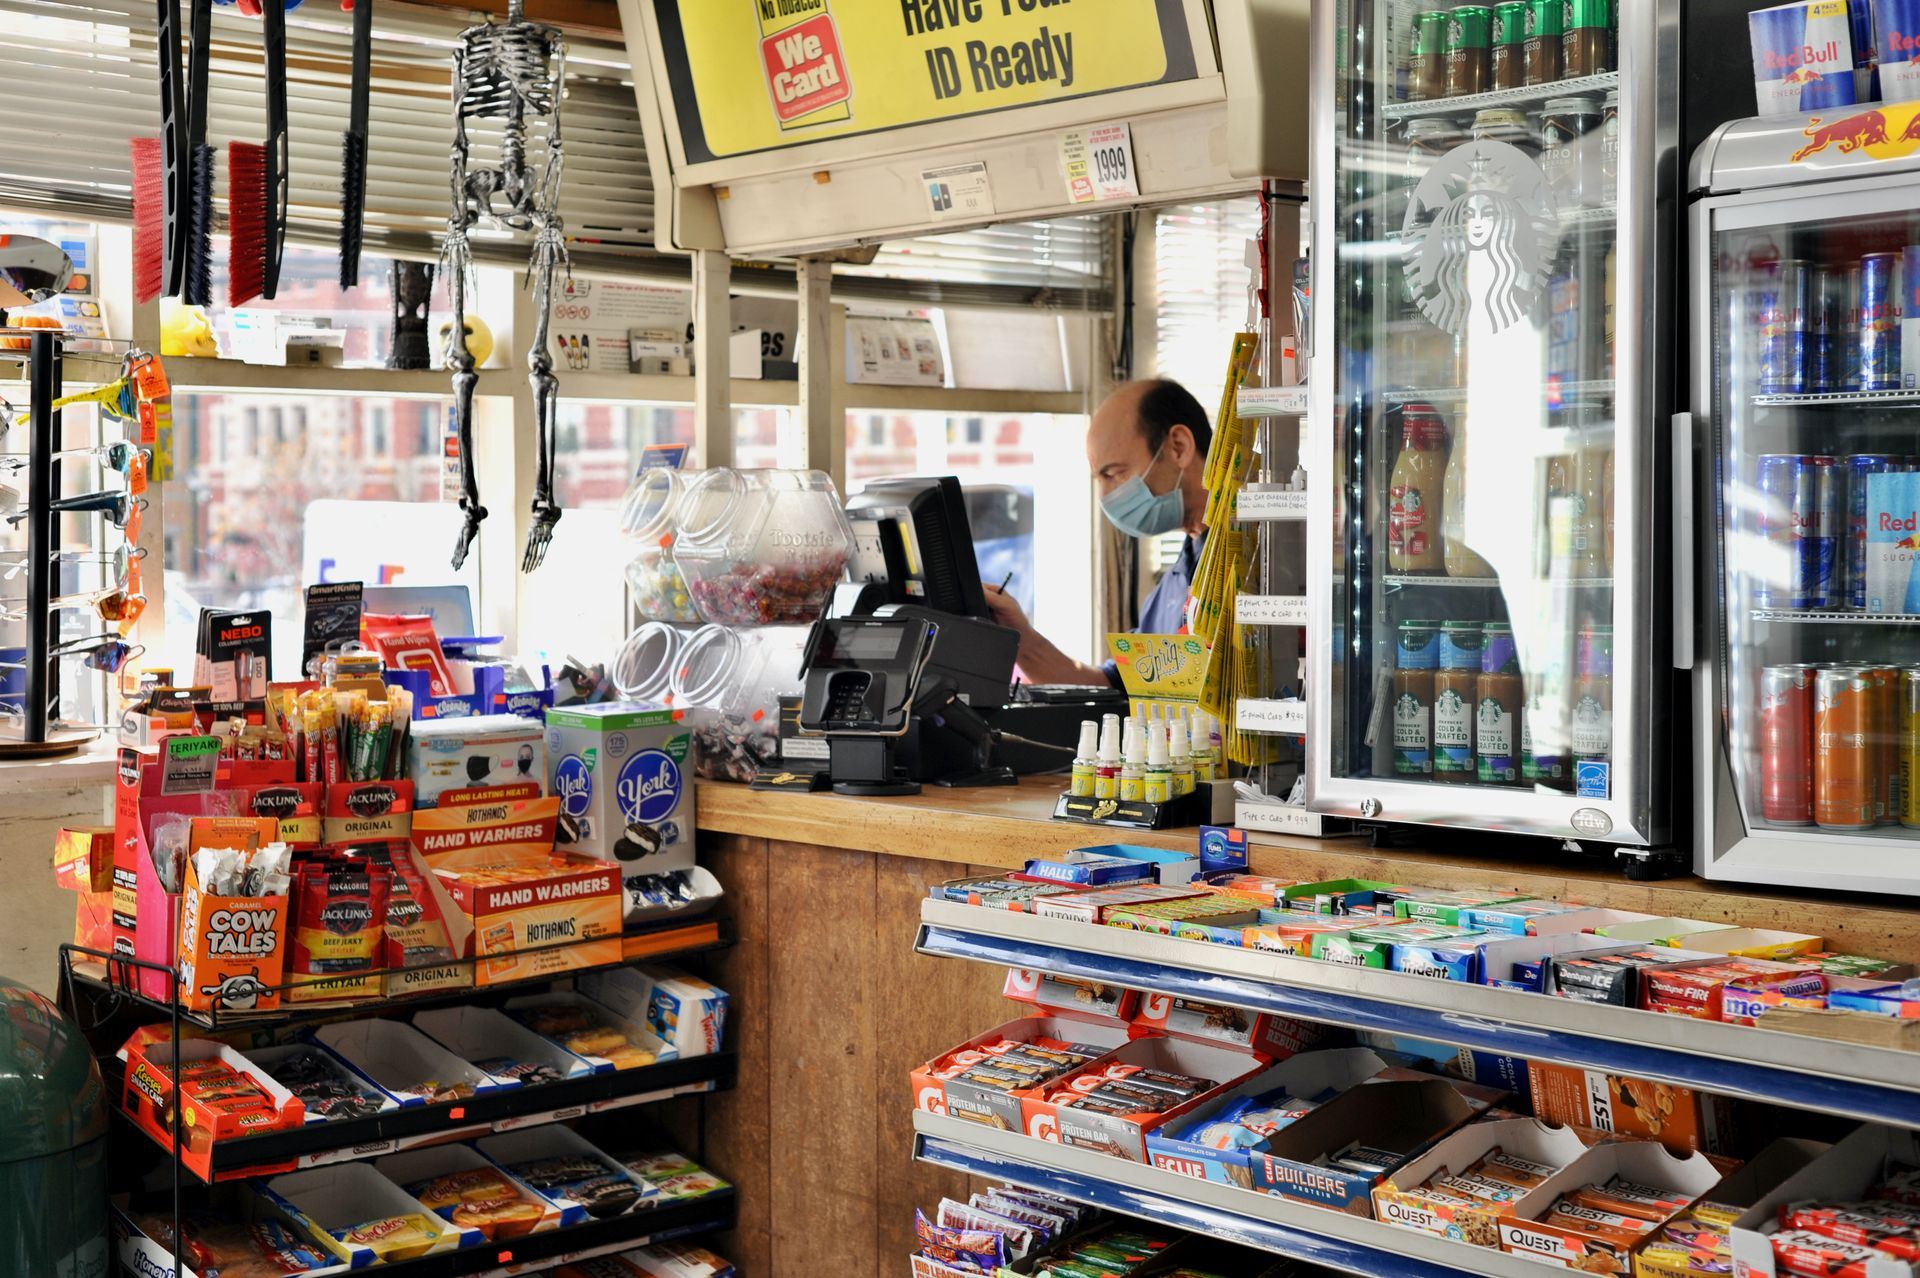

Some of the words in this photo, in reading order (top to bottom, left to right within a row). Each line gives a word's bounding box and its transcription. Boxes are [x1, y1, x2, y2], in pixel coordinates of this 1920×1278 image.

[1813, 6, 1820, 15] 4
[774, 31, 823, 70] We
[1764, 47, 1800, 68] Red
[1802, 41, 1838, 64] Bull
[925, 46, 962, 100] ID
[966, 26, 1073, 92] Ready
[772, 53, 841, 104] Card
[1094, 146, 1127, 182] 1999
[1880, 512, 1916, 531] Red
[769, 529, 833, 547] Tootsie
[310, 584, 360, 595] SmartKnife
[221, 626, 262, 640] NEBO
[382, 636, 404, 647] Hand
[405, 634, 430, 646] Wipes
[1136, 640, 1180, 683] Sprig
[1397, 728, 1413, 736] COLD
[1435, 732, 1468, 741] CRAFTED
[1438, 725, 1455, 733] COLD
[170, 741, 218, 753] TERIYAKI
[610, 737, 624, 746] 175
[1394, 735, 1426, 743] CRAFTED
[1479, 735, 1495, 743] COLD
[1573, 740, 1609, 750] CRAFTED
[346, 794, 369, 805] JACK
[369, 792, 396, 803] LINK'S
[450, 793, 470, 802] LONG
[472, 790, 504, 800] LASTING
[506, 788, 529, 797] HEAT!
[556, 766, 589, 815] York
[617, 759, 675, 824] York
[252, 797, 274, 808] JACK
[275, 795, 303, 807] LINK'S
[467, 806, 508, 823] HOTHANDS
[345, 820, 392, 833] ORIGINAL
[424, 833, 465, 850] HAND
[469, 824, 544, 845] WARMERS
[1039, 865, 1074, 881] HALLS
[339, 882, 369, 890] CALORIES
[489, 889, 533, 909] HAND
[536, 877, 611, 900] WARMERS
[320, 910, 344, 921] JACK
[345, 908, 373, 920] LINK'S
[397, 904, 424, 916] LINK'S
[209, 909, 278, 933] COW
[526, 917, 576, 944] HOTHANDS
[206, 932, 277, 954] TALES
[323, 938, 340, 946] BEEF
[341, 938, 363, 946] JERKY
[1322, 947, 1366, 966] Trident
[404, 967, 460, 984] ORIGINAL
[1402, 958, 1449, 979] Trident
[313, 976, 367, 990] TERIYAKI
[1560, 968, 1591, 983] Dentyne
[1591, 974, 1613, 988] ICE
[1651, 980, 1684, 995] Dentyne
[1779, 980, 1822, 995] mentos
[1498, 1058, 1508, 1080] CHIP
[135, 1063, 162, 1094] Reese's
[131, 1073, 150, 1096] SNACK
[149, 1087, 164, 1108] CAKE
[947, 1099, 975, 1113] PROTEIN
[976, 1104, 992, 1116] BAR
[1060, 1122, 1093, 1140] PROTEIN
[1093, 1130, 1109, 1143] BAR
[1177, 1145, 1201, 1154] CHOCOLATE
[1165, 1159, 1204, 1179] CLIF
[1495, 1153, 1540, 1172] QUEST
[1275, 1165, 1347, 1197] BUILDERS
[1441, 1176, 1483, 1194] QUEST
[1617, 1181, 1669, 1198] QUEST
[1293, 1184, 1331, 1199] PROTEIN
[1388, 1204, 1433, 1226] QUEST
[1558, 1203, 1608, 1221] QUEST
[1510, 1229, 1560, 1253] QUEST
[1791, 1234, 1864, 1255] bueno
[915, 1260, 930, 1274] BIG
[1640, 1263, 1656, 1274] TRY
[1658, 1268, 1689, 1278] THESE
